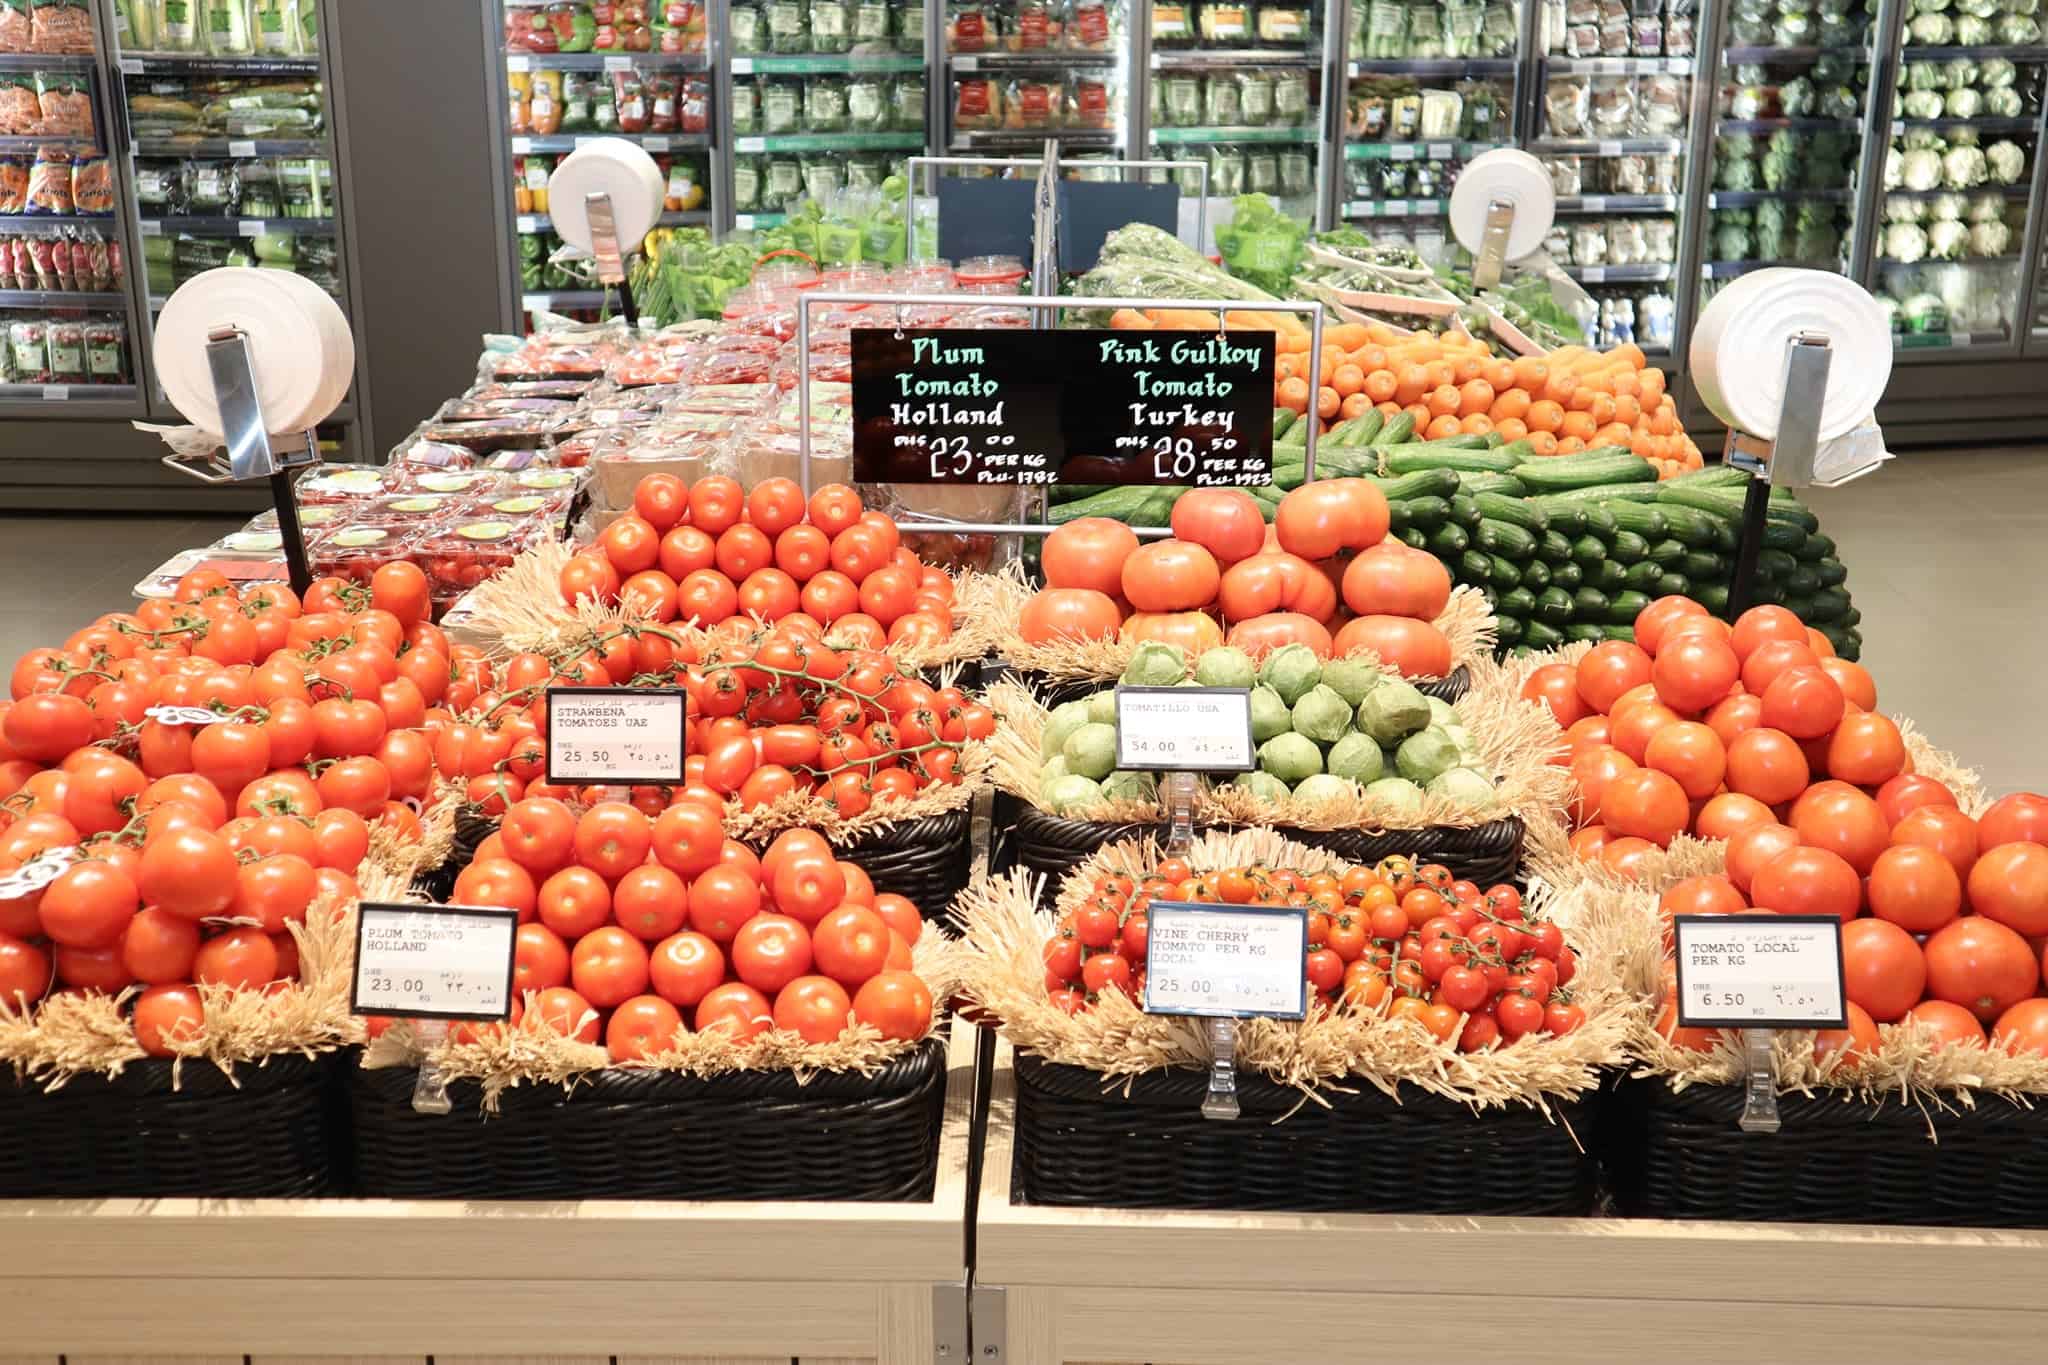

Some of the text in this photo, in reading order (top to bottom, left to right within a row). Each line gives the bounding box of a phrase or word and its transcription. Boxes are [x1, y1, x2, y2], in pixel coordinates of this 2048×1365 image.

[912, 337, 985, 364] Plum
[1099, 338, 1262, 373] Pink Gulkoy
[895, 373, 999, 397] Tomato
[1133, 370, 1233, 397] Tomato
[890, 401, 1004, 426] Holland
[1128, 403, 1235, 432] Turkey
[984, 454, 1046, 467] PER KG
[1203, 458, 1266, 471] PER KG
[558, 708, 626, 717] STRAWBENA
[1123, 703, 1221, 713] TOMATILLO USA
[558, 718, 648, 728] TOMATOES UAE
[1131, 741, 1176, 752] 54.00
[563, 751, 609, 762] 25.50
[368, 927, 463, 941] PLUM TOMATO
[1153, 928, 1249, 943] VINE CHERRY
[366, 940, 428, 952] HOLLAND
[1153, 940, 1266, 957] TOMATO PER KG
[1690, 943, 1800, 953] TOMATO LOCAL
[1152, 953, 1195, 964] LOCAL
[1691, 956, 1746, 966] PER KG
[371, 978, 424, 993] 23.00
[1159, 978, 1212, 993] 25.00
[1703, 993, 1745, 1006] 6.50
